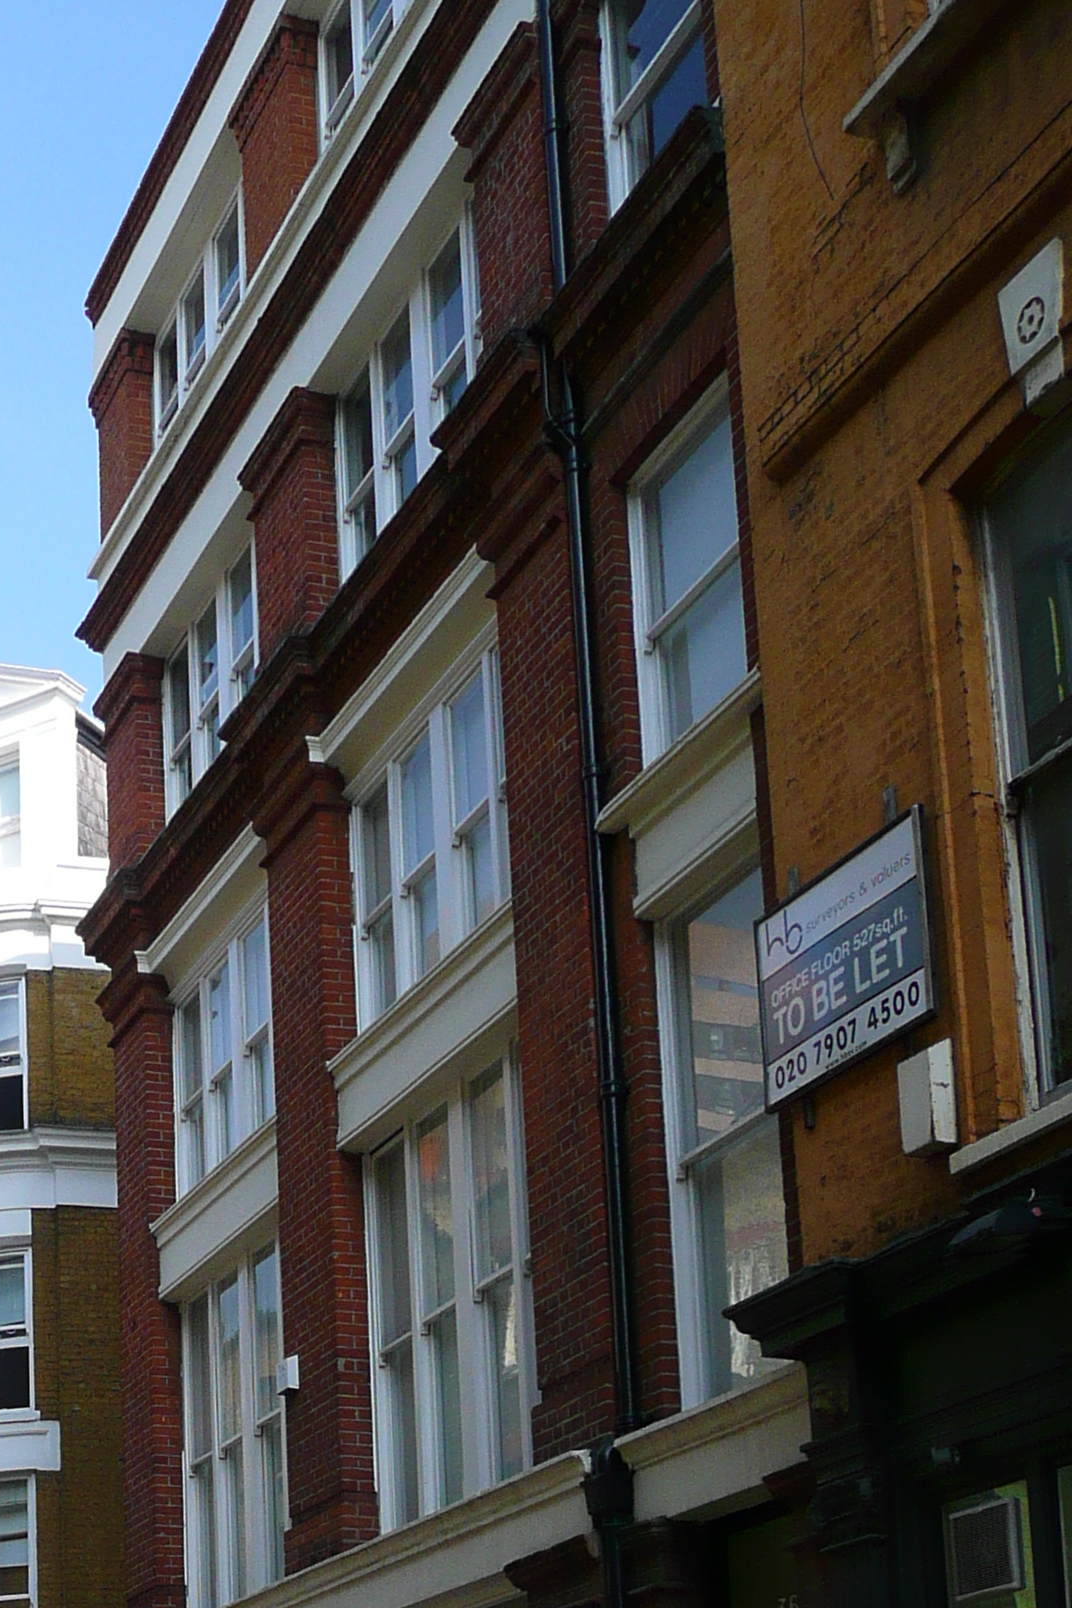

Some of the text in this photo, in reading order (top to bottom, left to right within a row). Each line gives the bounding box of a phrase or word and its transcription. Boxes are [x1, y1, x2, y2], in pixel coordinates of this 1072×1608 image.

[765, 909, 803, 956] hb
[805, 852, 912, 934] surveyors & valuers
[771, 967, 810, 1008] OFFICE
[811, 940, 851, 980] FLOOR
[772, 926, 909, 1045] TO BE LET
[775, 980, 921, 1090] 020 7907 4500
